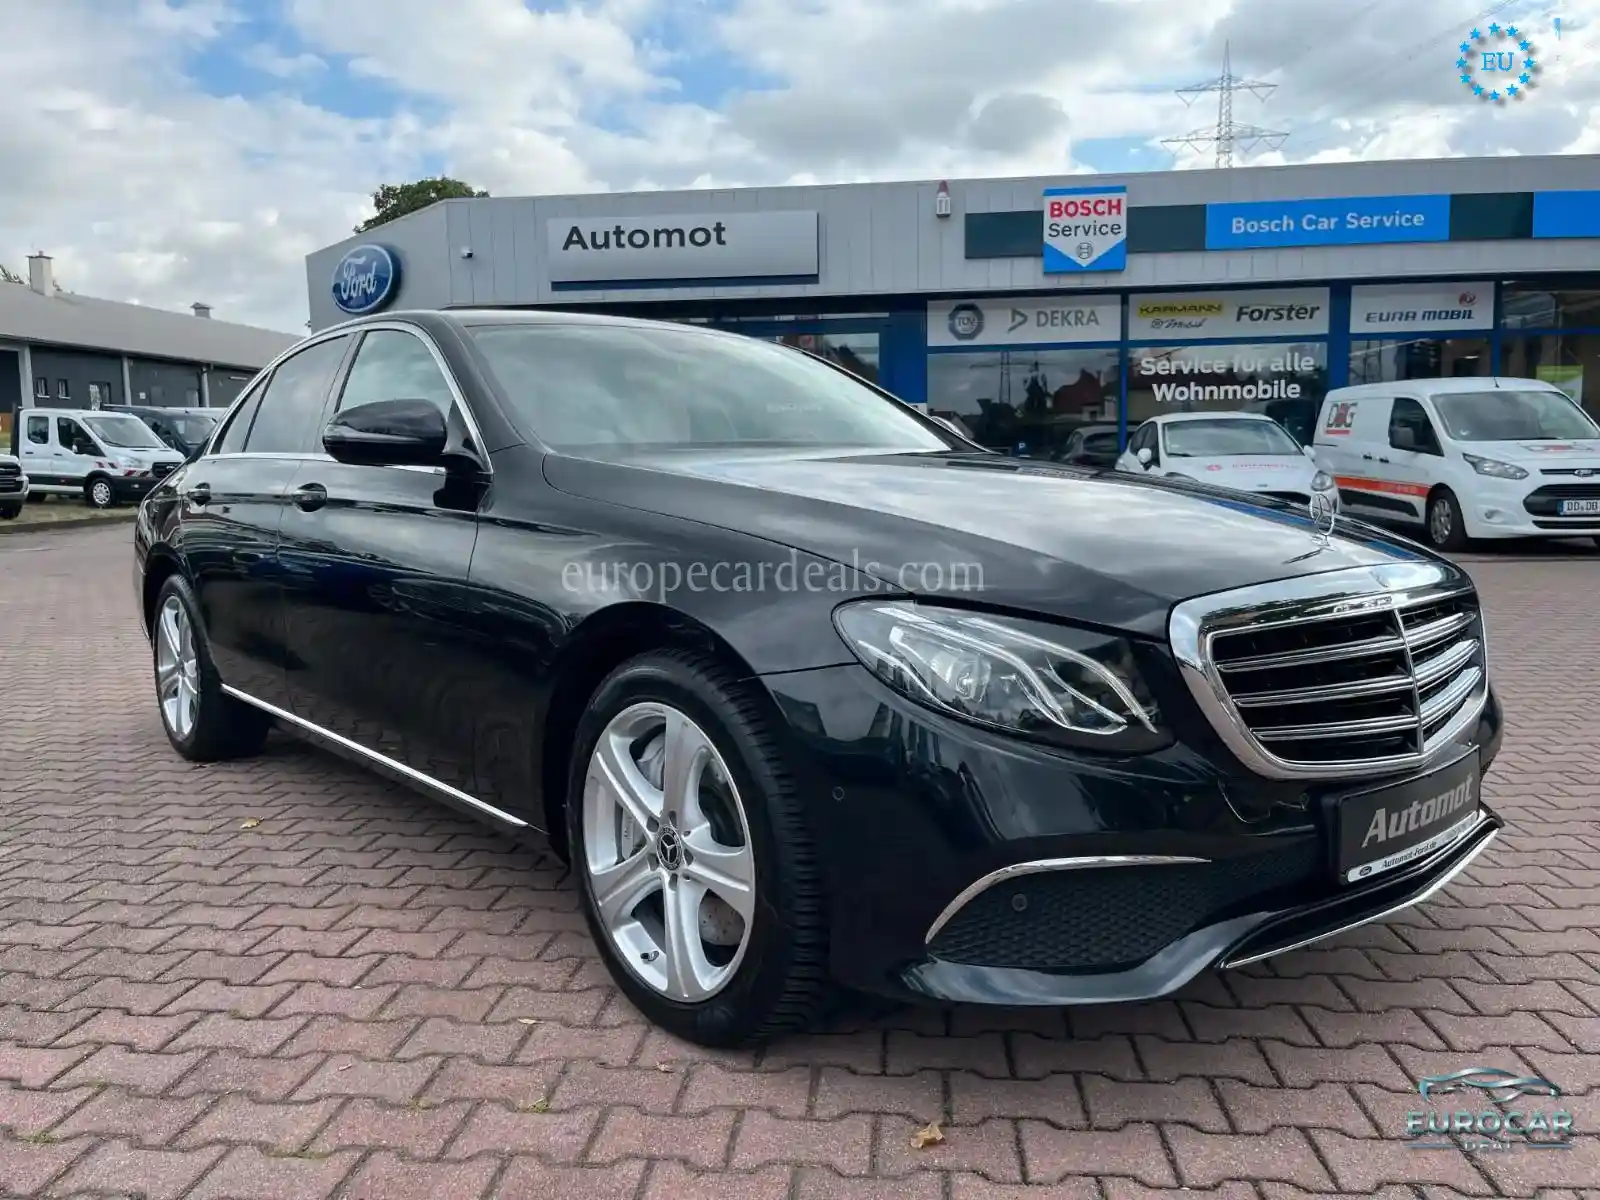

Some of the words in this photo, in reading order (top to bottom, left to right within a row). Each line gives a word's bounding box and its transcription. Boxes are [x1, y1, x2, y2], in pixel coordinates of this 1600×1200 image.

[1049, 198, 1122, 218] BOSCH
[1048, 220, 1122, 238] Service
[1231, 214, 1294, 234] Bosch
[1302, 213, 1338, 231] Car
[1346, 210, 1425, 229] Service
[562, 221, 727, 251] Automot
[341, 255, 378, 301] Ford
[1036, 309, 1099, 328] DEKRA
[1140, 303, 1222, 314] KARMANN
[1236, 302, 1320, 322] Forster
[1421, 308, 1475, 321] MOBIL
[1140, 356, 1226, 376] Service
[1270, 352, 1315, 373] alle
[1152, 379, 1301, 402] Wohnmobile
[1361, 773, 1474, 848] Automot
